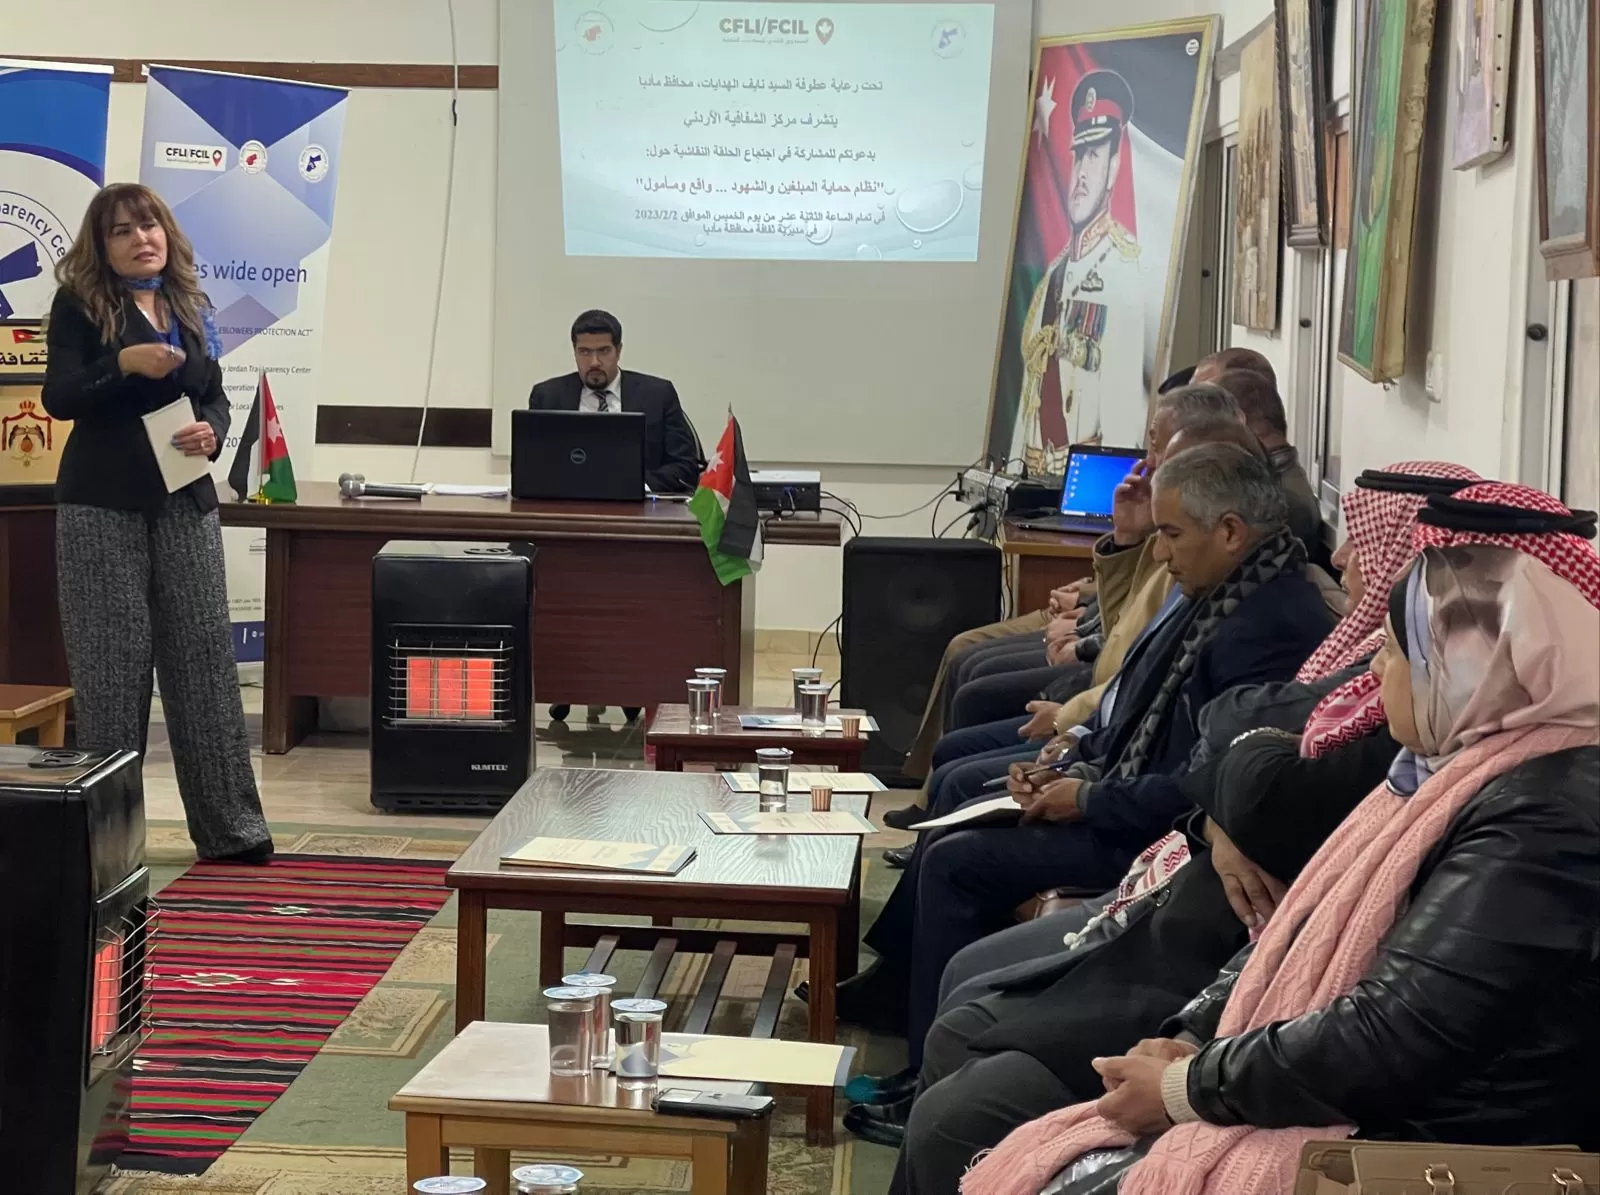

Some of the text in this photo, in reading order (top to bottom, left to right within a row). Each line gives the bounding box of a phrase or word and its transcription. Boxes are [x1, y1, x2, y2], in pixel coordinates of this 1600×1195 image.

[719, 16, 809, 36] CFLI/FCIL
[663, 74, 694, 88] محافظ
[742, 77, 765, 93] نايف
[767, 78, 793, 93] السيد
[795, 77, 827, 94] عطوفة
[830, 77, 859, 94] رعاية
[861, 79, 883, 91] تحت
[683, 109, 839, 129] يتشرف مركز الشفافية الأردني
[645, 143, 876, 163] بدعوتكم للمشاركة في اجتماع الحلقة النقاشية حول:
[689, 177, 713, 195] واقع
[731, 179, 775, 195] والشهود
[777, 179, 818, 195] المبلغين
[820, 179, 852, 195] حماية
[634, 208, 678, 221] 2023/2/2
[680, 208, 711, 223] الموافق
[713, 210, 745, 223] الخميس
[747, 212, 762, 223] يوم
[763, 212, 775, 222] من
[778, 212, 797, 222] عشر
[825, 210, 854, 222] الساعة
[855, 211, 872, 224] تمام
[723, 222, 754, 234] محافظة
[213, 260, 257, 281] wide
[261, 266, 308, 288] open
[254, 327, 296, 337] PROTECTION
[227, 364, 249, 373] Jordan
[291, 366, 312, 374] Center
[225, 436, 242, 448] 20
